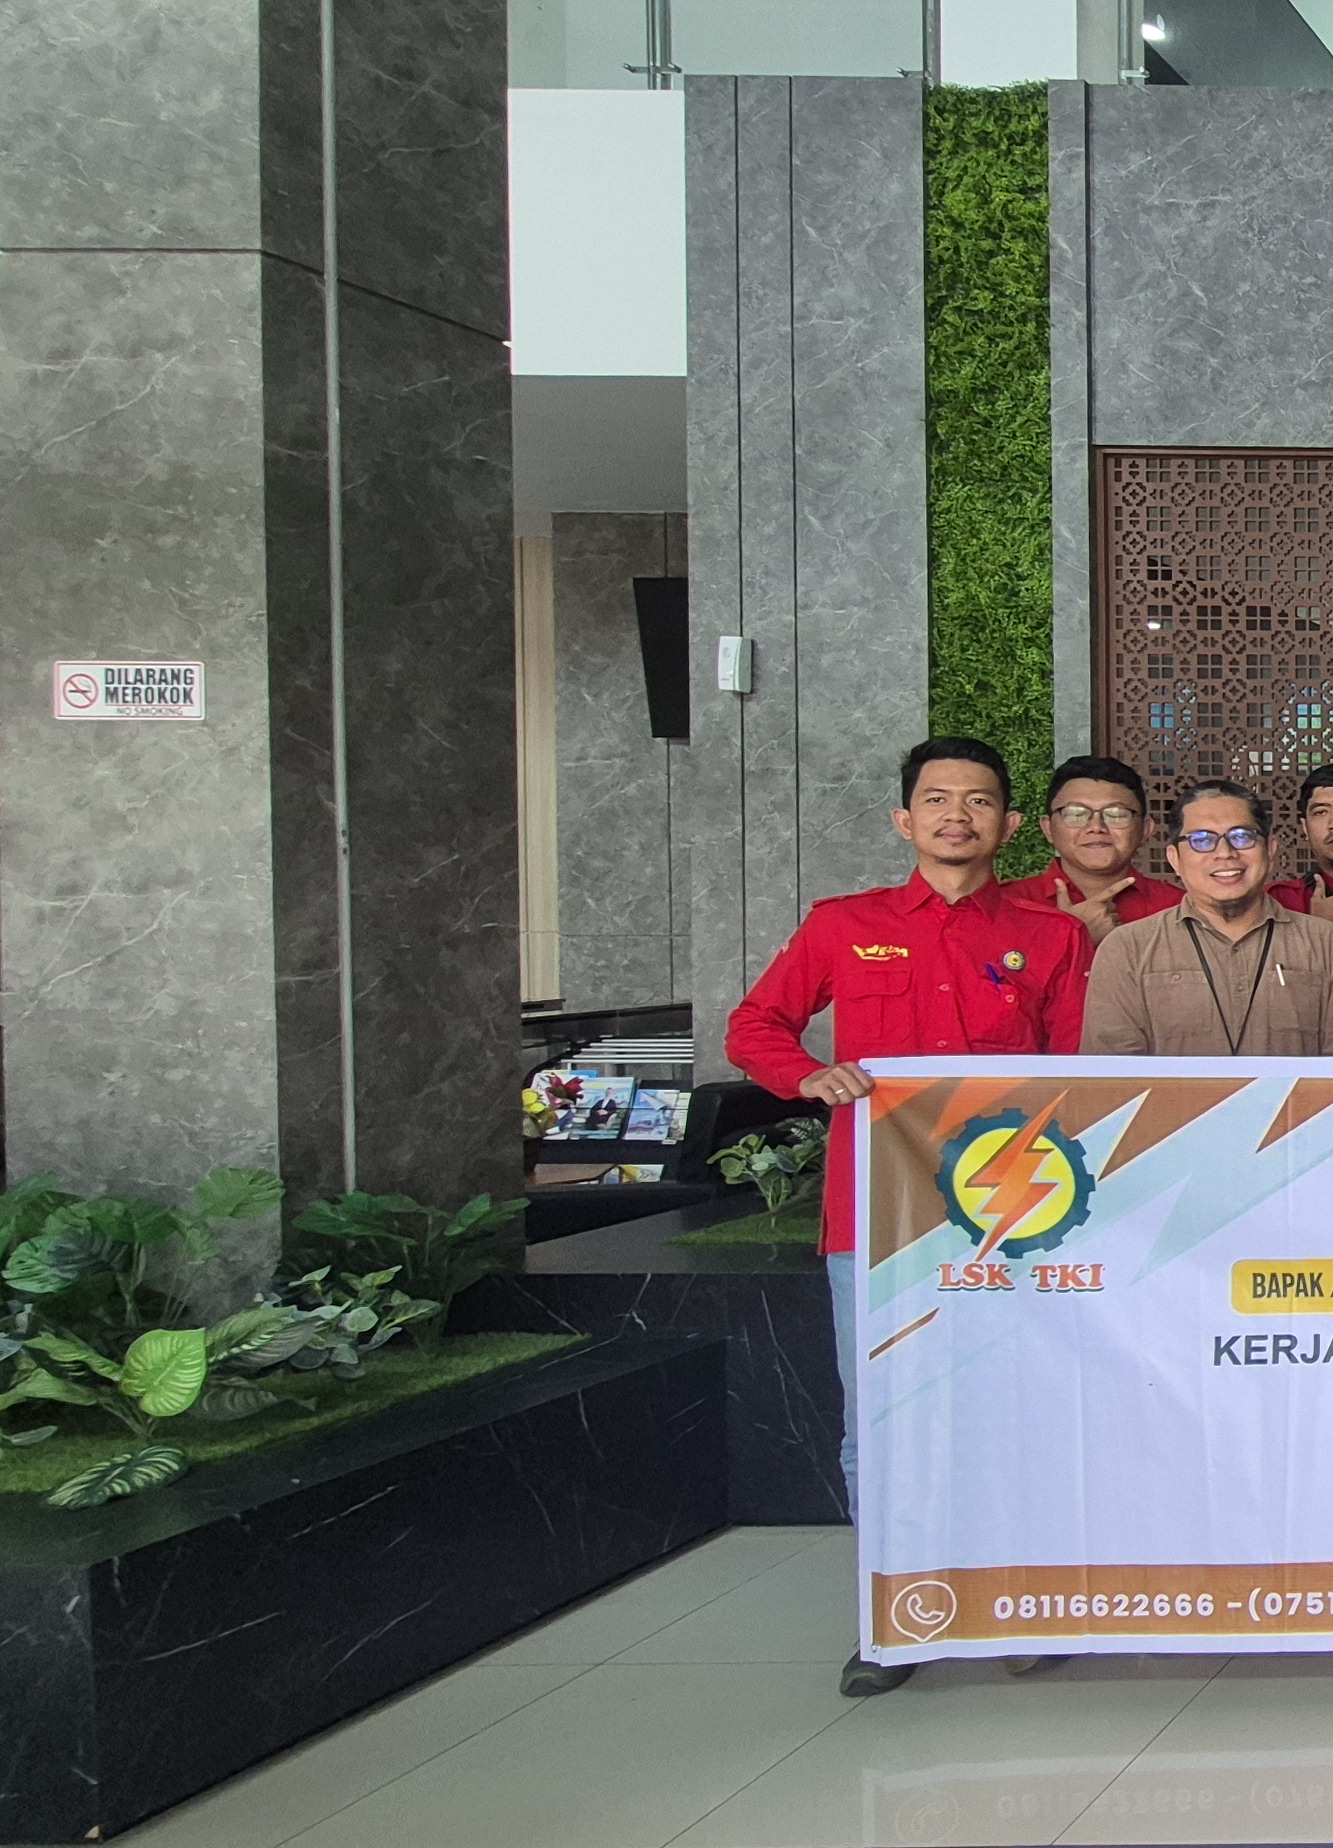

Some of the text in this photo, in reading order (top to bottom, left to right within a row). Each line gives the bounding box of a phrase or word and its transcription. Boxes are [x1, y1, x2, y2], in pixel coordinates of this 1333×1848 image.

[104, 667, 195, 685] DILARANG
[104, 686, 194, 704] MEROKOK
[116, 707, 183, 716] NO SMOKING
[936, 1263, 1106, 1292] LSK TKI
[1251, 1273, 1324, 1299] BAPAK
[993, 1594, 1216, 1620] 08116622666
